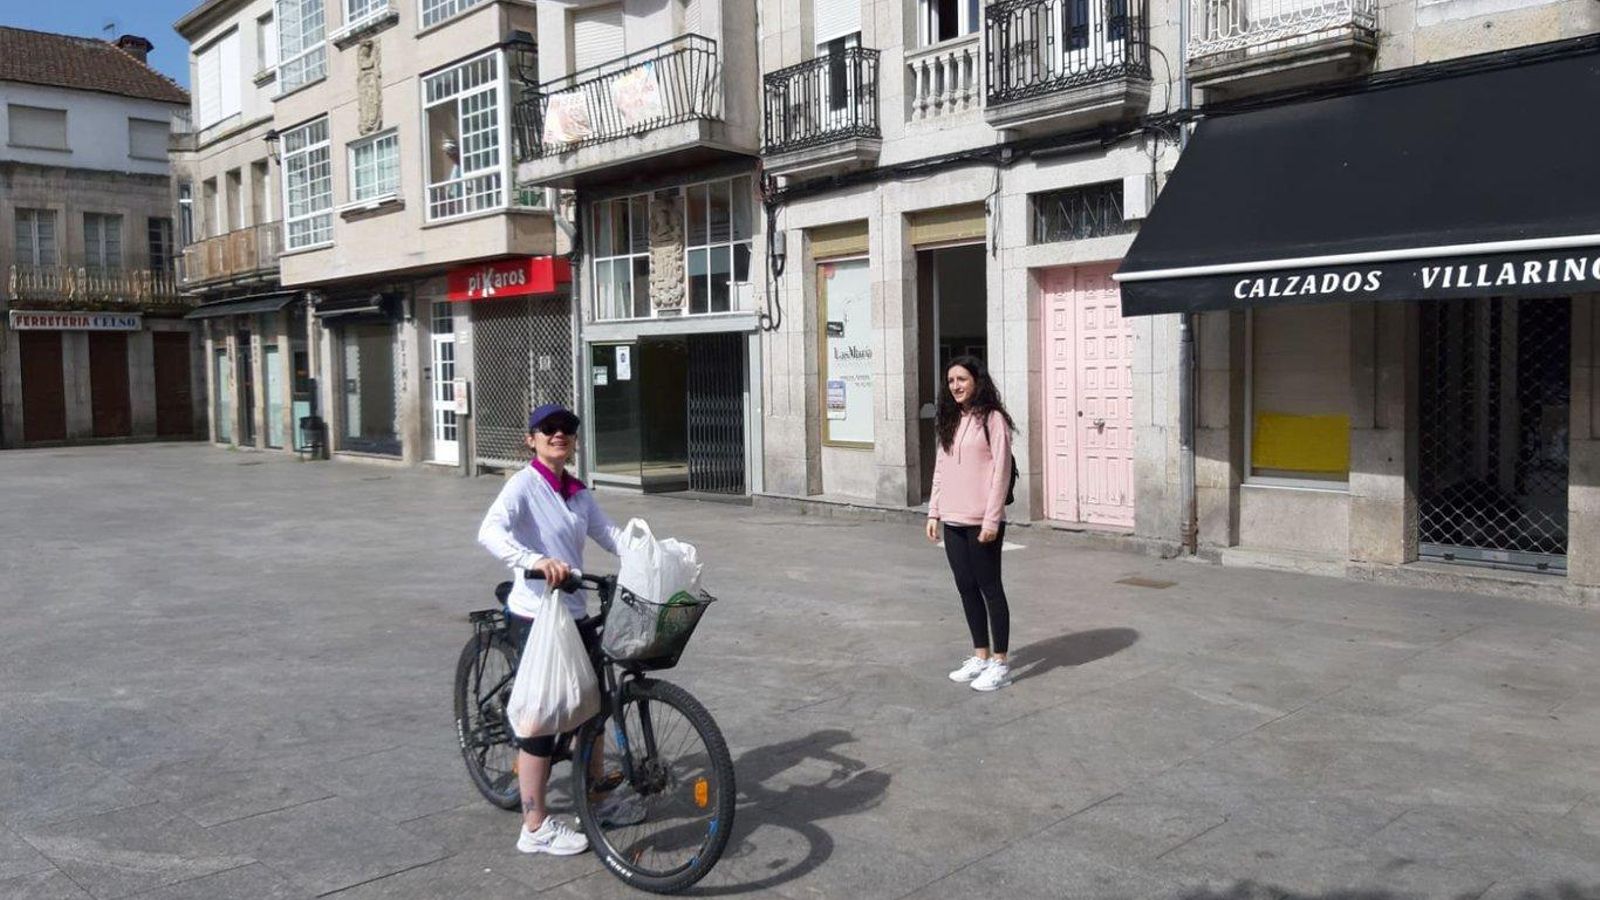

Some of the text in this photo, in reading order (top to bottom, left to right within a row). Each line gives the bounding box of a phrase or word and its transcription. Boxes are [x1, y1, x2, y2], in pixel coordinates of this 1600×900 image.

[1234, 270, 1382, 299] CALZADOS
[15, 315, 136, 327] FERRETERIA CELSO
